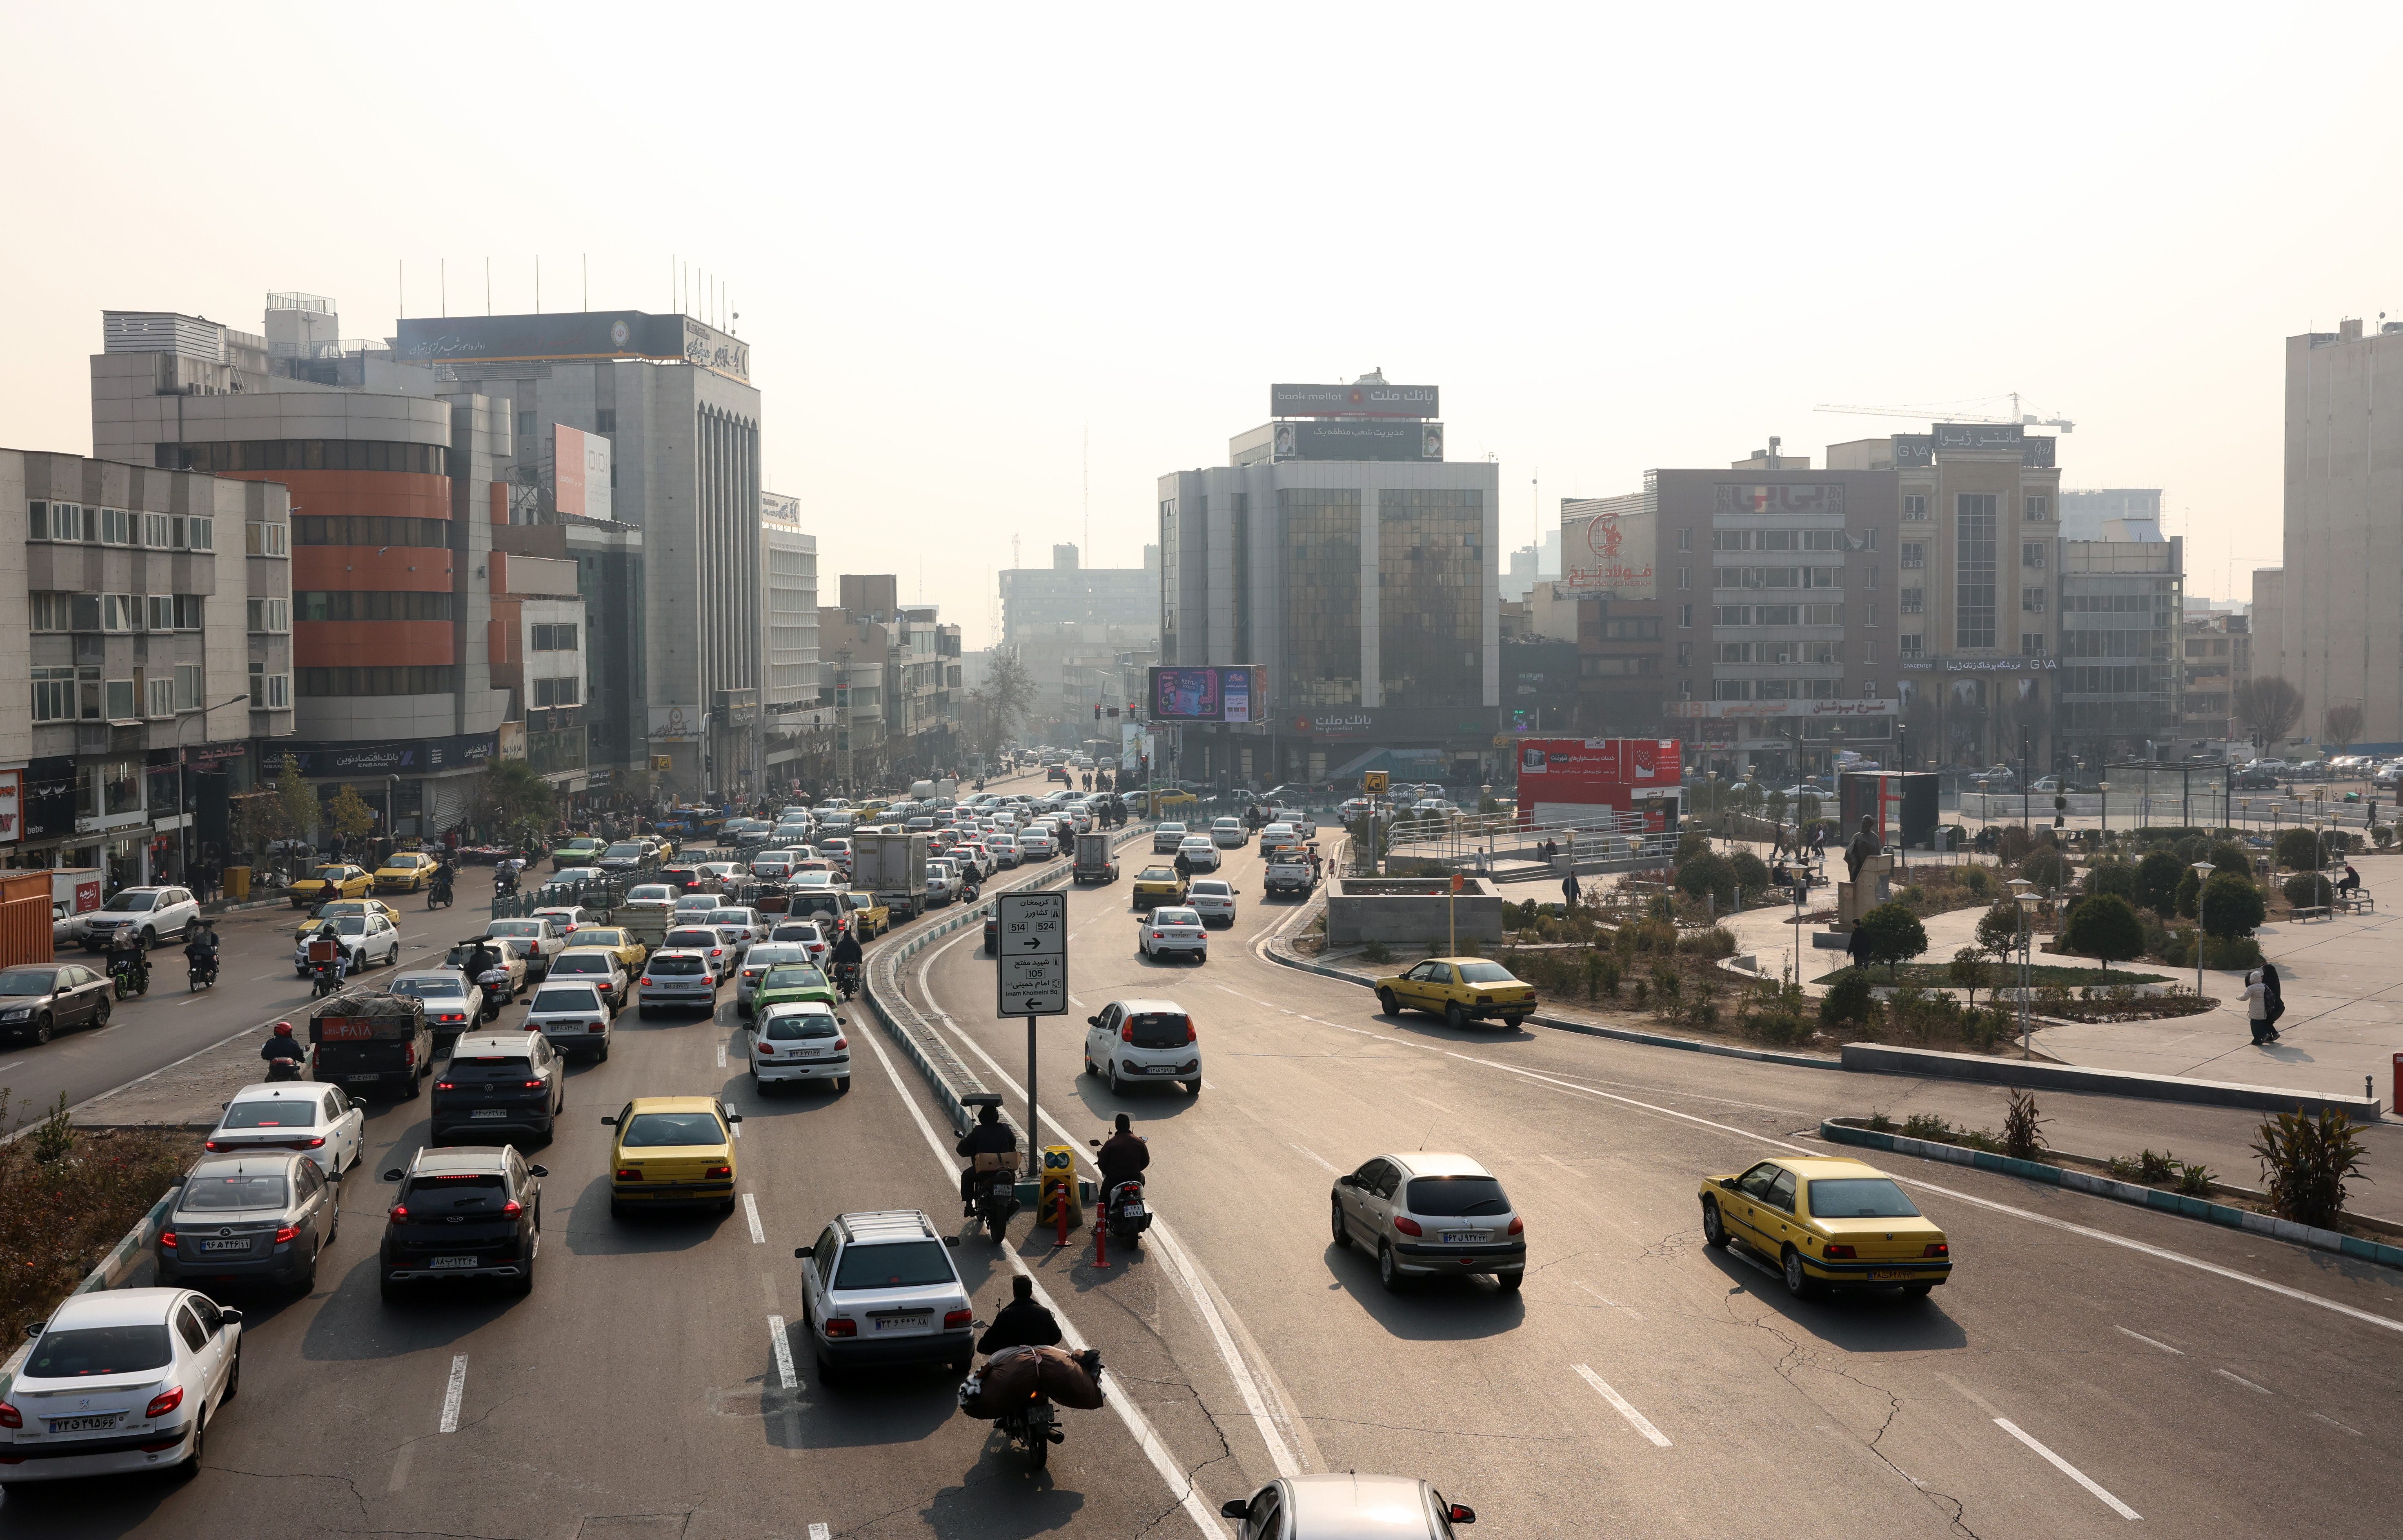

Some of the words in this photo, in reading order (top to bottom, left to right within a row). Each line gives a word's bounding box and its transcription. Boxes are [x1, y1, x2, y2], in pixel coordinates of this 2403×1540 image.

[1371, 390, 1400, 400] ملت
[1404, 390, 1434, 404] بانک
[1313, 427, 1326, 437] یک
[1327, 427, 1351, 436] منطقه
[1353, 427, 1373, 438] شعب
[1373, 428, 1404, 438] مدیریت
[1940, 429, 1971, 447] ژیوا
[1976, 431, 2020, 447] مانتو
[1569, 564, 1602, 587] نرخ
[1604, 563, 1652, 580] فولاد
[1946, 661, 1962, 670] ژیوا
[1963, 661, 1976, 670] زنانه
[1976, 660, 1997, 671] پوشاک
[1998, 660, 2020, 670] فروشگاه
[1813, 701, 1855, 714] پوشان
[1316, 715, 1342, 724] ملت
[1345, 714, 1371, 729] بانک
[198, 744, 245, 760] کاندید
[380, 753, 398, 763] بانک
[27, 826, 43, 834] bebe
[1020, 898, 1050, 907] کریمخان
[1024, 909, 1048, 918] کشاورز
[1011, 923, 1026, 931] 514
[1014, 959, 1030, 969] مفتح
[1012, 981, 1033, 989] خمینی
[1035, 980, 1050, 989] امام
